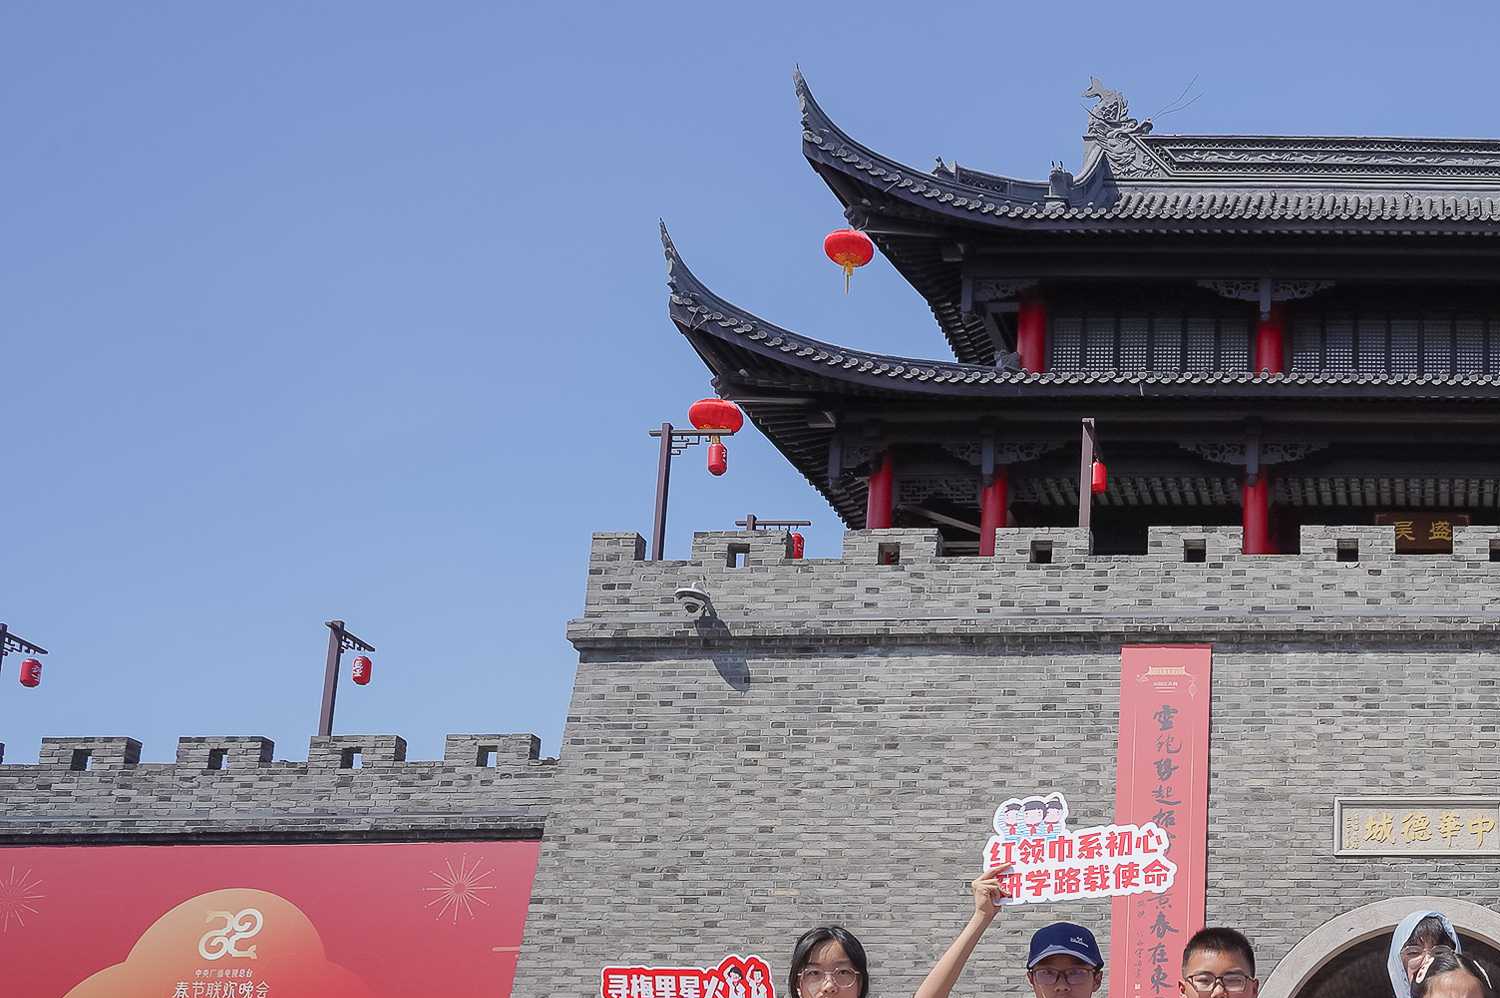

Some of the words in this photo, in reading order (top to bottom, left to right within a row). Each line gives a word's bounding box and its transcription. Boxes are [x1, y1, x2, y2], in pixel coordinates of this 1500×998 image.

[989, 828, 1163, 868] 红领巾系初心
[996, 858, 1171, 899] 研学路载使命
